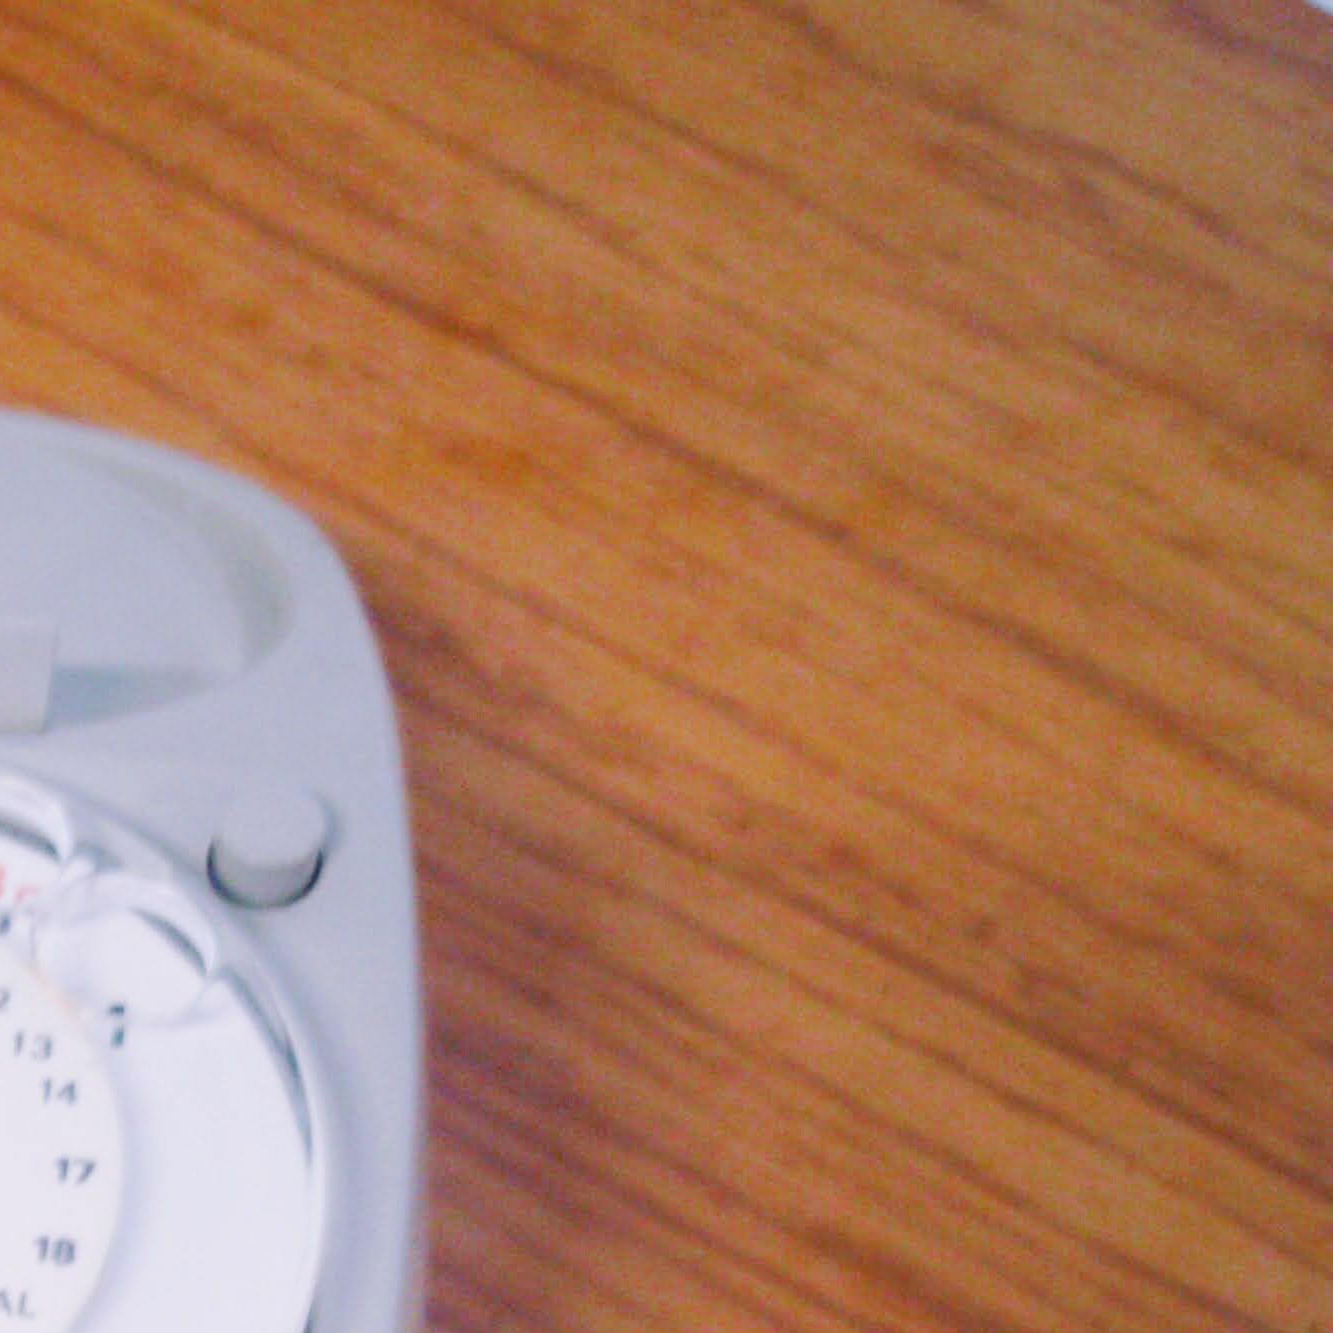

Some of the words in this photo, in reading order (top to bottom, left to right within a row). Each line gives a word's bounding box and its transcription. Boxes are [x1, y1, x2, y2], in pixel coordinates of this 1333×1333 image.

[12, 1029, 53, 1061] 13
[42, 1076, 79, 1105] 14
[56, 1155, 97, 1185] 17
[35, 1235, 77, 1266] 18
